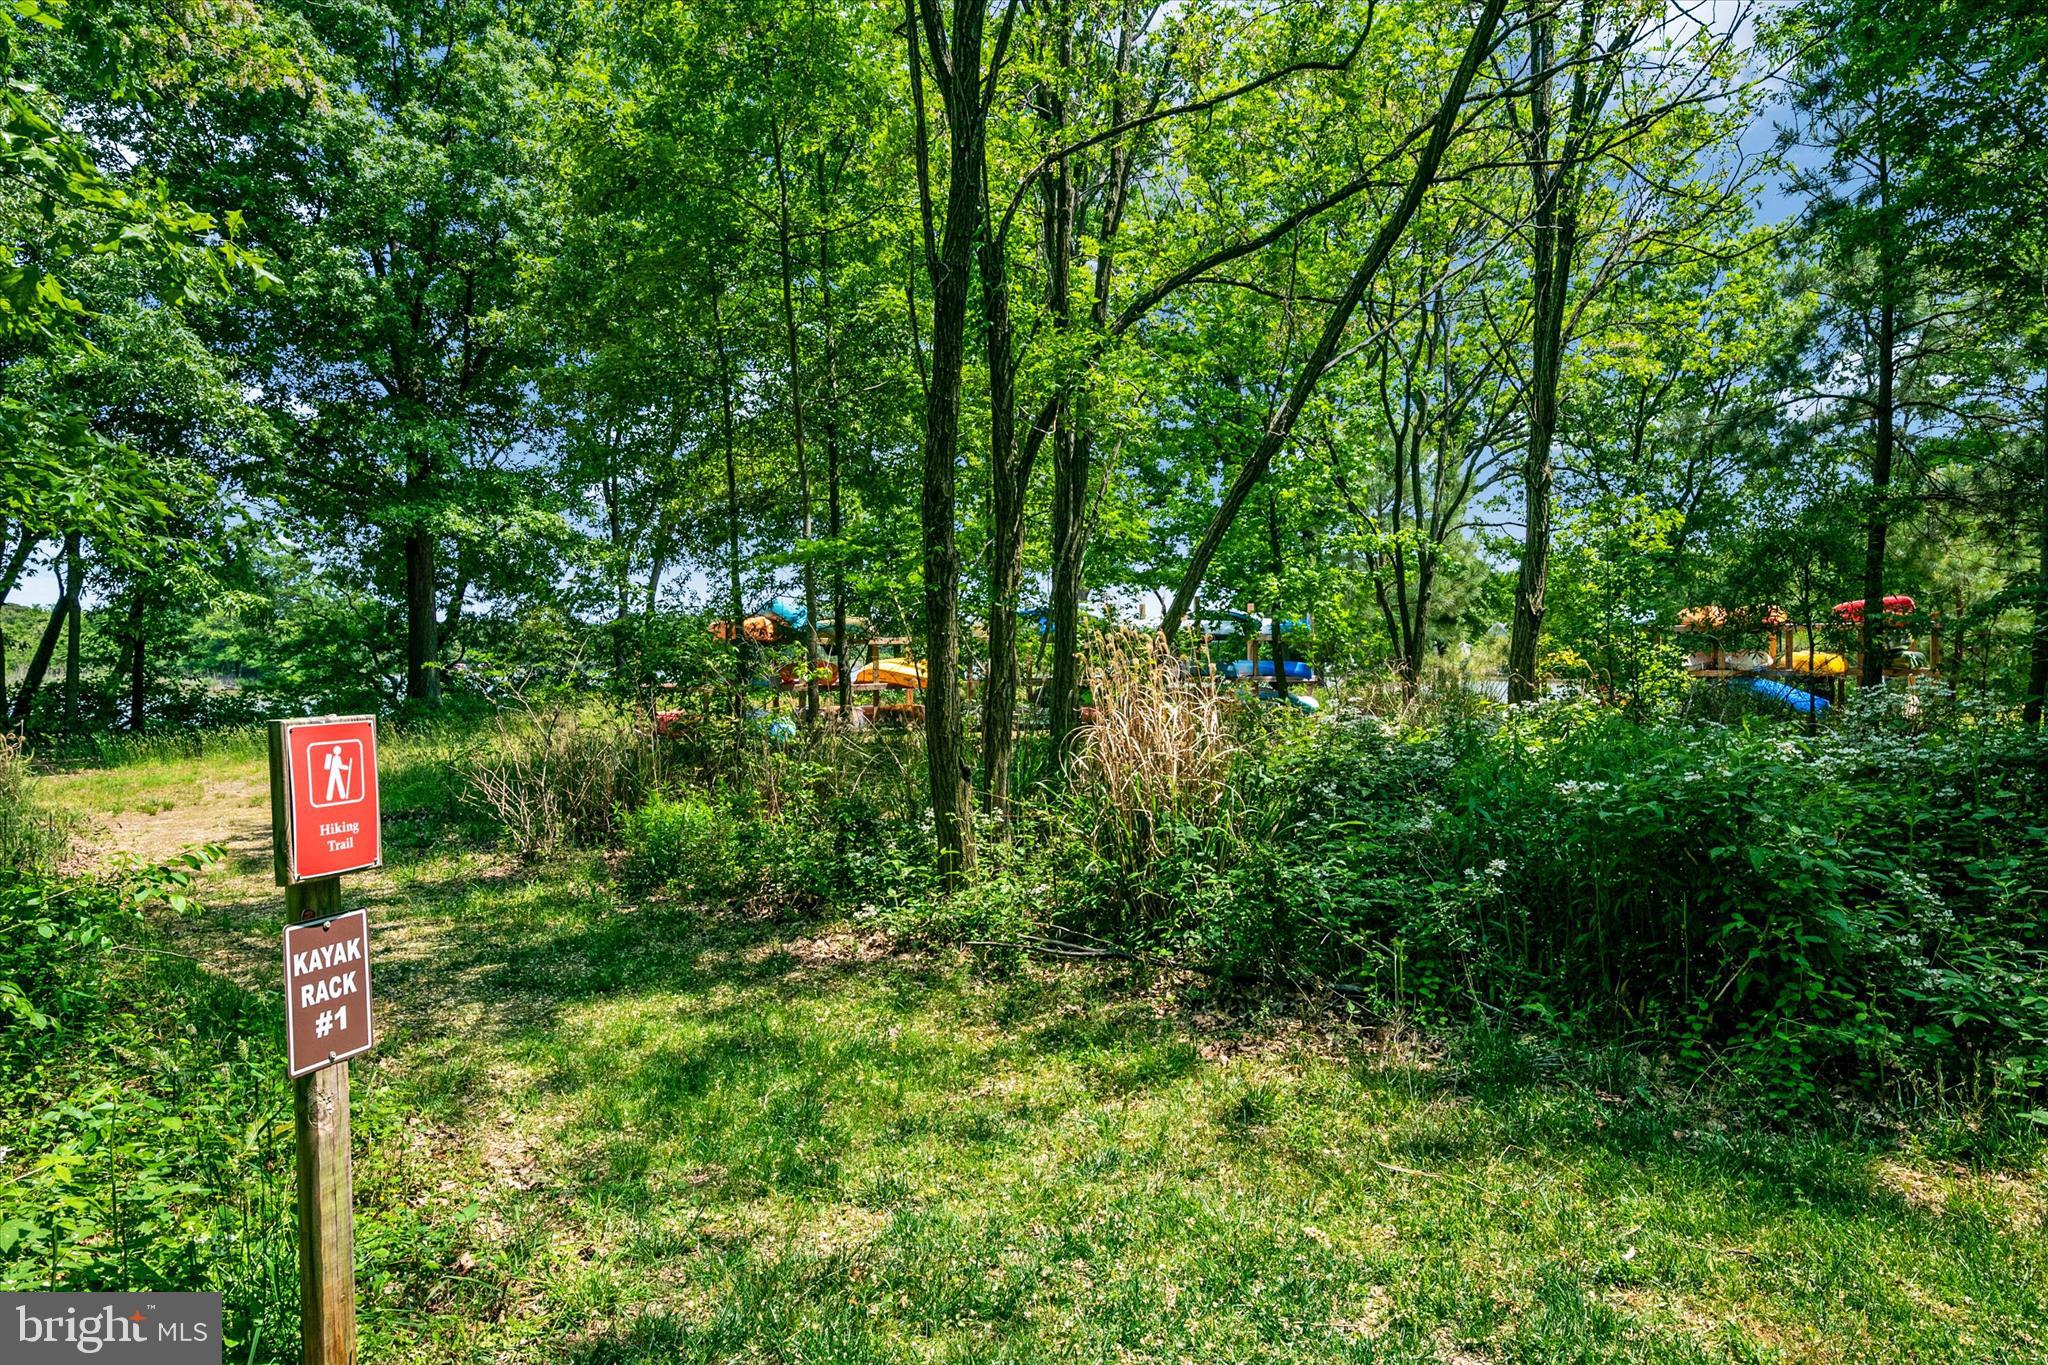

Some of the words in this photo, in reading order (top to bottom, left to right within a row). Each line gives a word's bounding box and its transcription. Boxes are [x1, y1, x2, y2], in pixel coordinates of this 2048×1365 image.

[320, 821, 359, 836] Hiking
[327, 837, 353, 851] Trail
[293, 937, 361, 977] KAYAK
[301, 971, 357, 1008] RACK
[315, 1005, 347, 1039] #1
